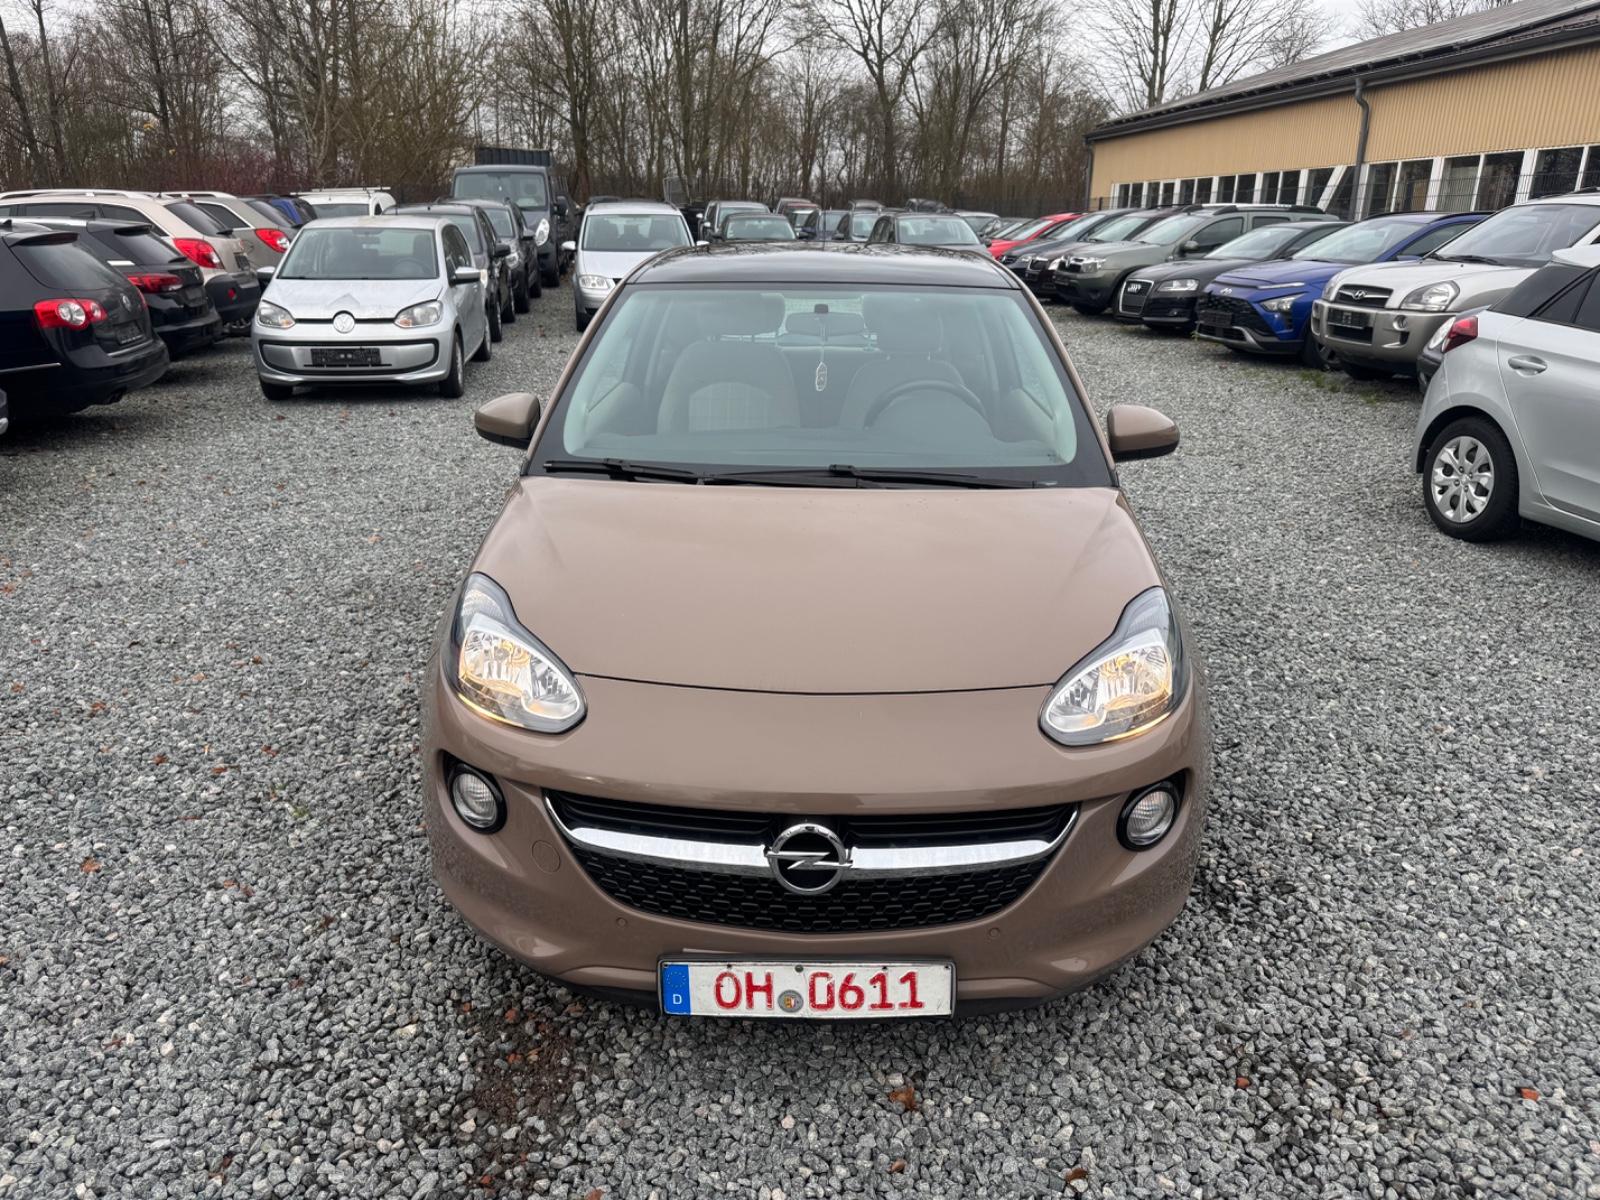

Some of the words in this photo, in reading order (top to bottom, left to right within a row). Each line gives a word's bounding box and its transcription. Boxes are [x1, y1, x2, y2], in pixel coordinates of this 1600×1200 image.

[672, 993, 682, 1005] D
[714, 971, 774, 1009] OH
[808, 971, 924, 1009] 0611
